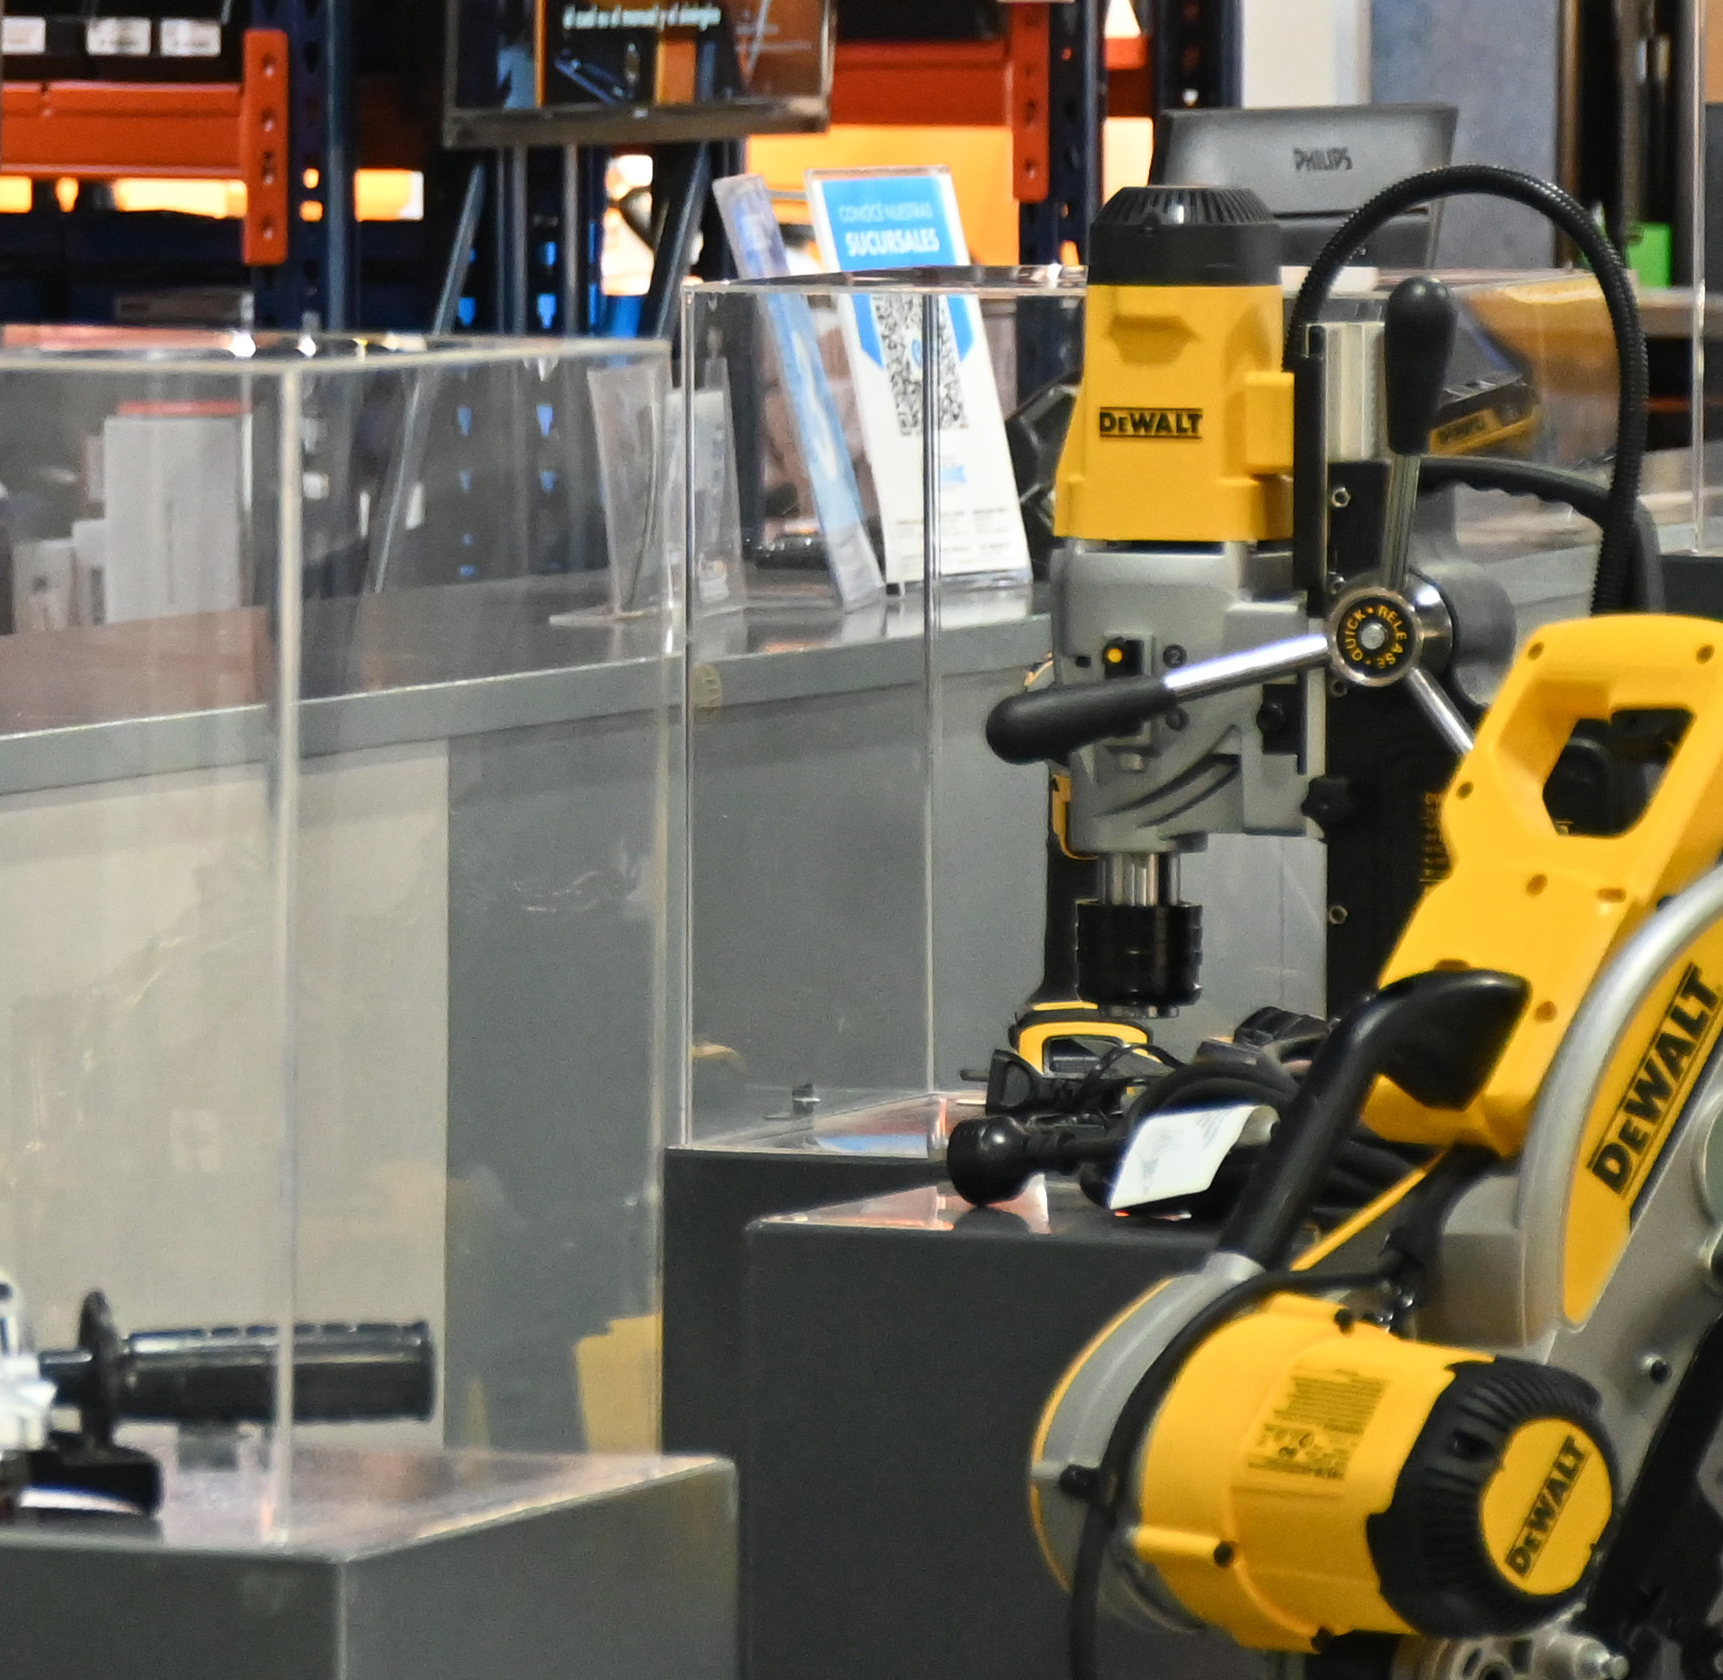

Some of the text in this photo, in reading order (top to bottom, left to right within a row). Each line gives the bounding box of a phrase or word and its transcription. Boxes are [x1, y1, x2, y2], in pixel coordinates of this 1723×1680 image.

[1293, 146, 1353, 172] PHILIPS
[845, 227, 941, 257] SUCURSALES
[1099, 411, 1203, 434] DEWALT
[1344, 608, 1367, 662] QUICK
[1376, 604, 1408, 669] RELEASE
[1589, 966, 1717, 1192] DEWALT
[1505, 1437, 1584, 1578] DEWALT
